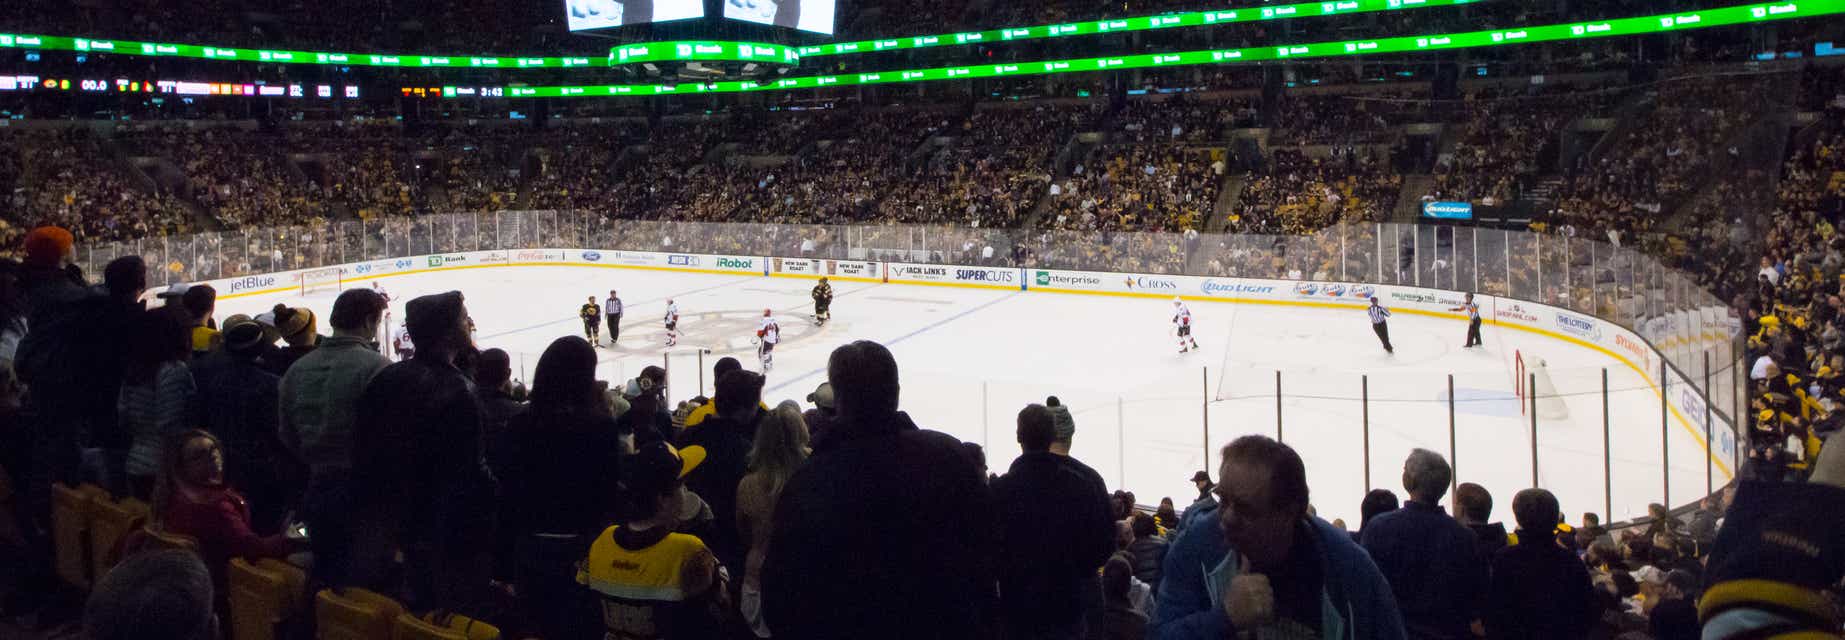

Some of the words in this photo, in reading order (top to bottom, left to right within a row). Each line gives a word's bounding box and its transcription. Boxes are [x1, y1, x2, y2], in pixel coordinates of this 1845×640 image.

[82, 80, 107, 90] 00.0
[481, 86, 503, 97] 3:42
[717, 257, 752, 269] iRobot
[956, 269, 1013, 282] SUPERCUTS
[230, 276, 275, 293] jetBlue
